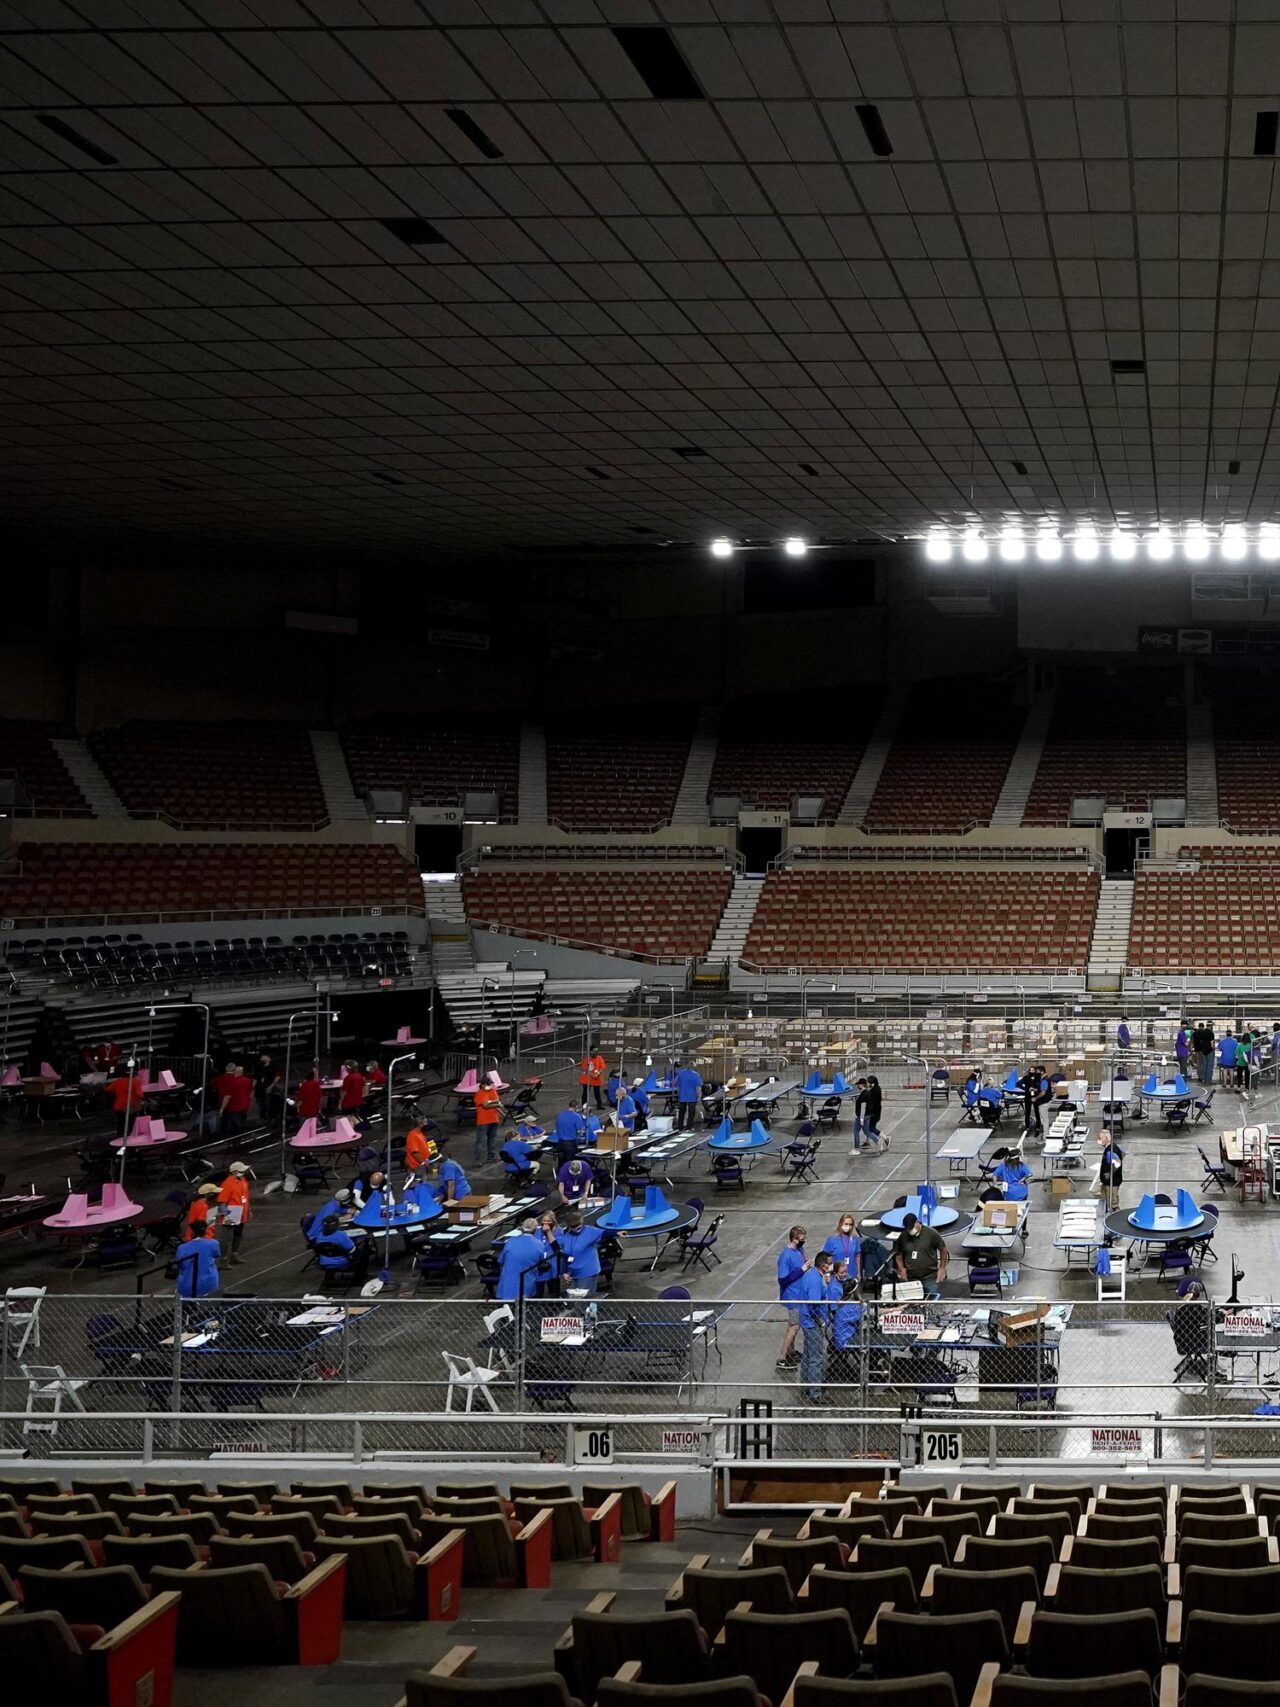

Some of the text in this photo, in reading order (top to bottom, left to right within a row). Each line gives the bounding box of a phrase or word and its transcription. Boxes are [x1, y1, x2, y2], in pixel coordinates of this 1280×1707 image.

[444, 812, 456, 821] 10
[1135, 816, 1145, 824] 12
[543, 1318, 581, 1328] NATIONAL
[884, 1315, 923, 1324] NATIONAL
[1225, 1317, 1265, 1327] NATIONAL
[664, 1432, 700, 1444] NATION
[1092, 1430, 1142, 1441] NATIONAL
[215, 1443, 265, 1453] NATIONAL
[927, 1434, 959, 1461] 205
